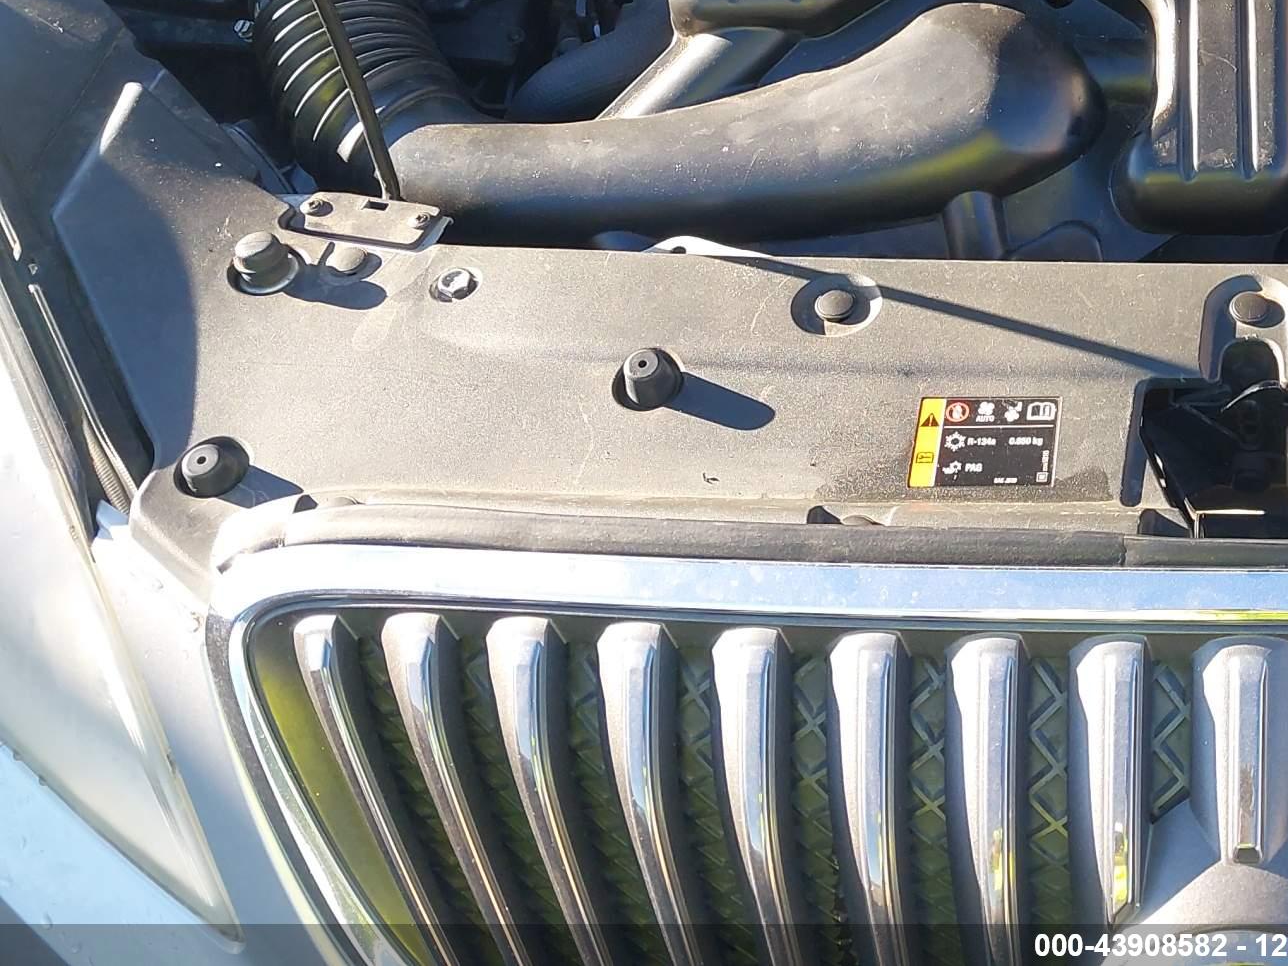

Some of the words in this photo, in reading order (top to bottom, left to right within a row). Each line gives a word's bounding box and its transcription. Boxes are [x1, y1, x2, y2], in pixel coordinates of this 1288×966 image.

[975, 414, 996, 422] AUTO
[966, 436, 997, 446] R-134a
[1032, 436, 1044, 446] kg
